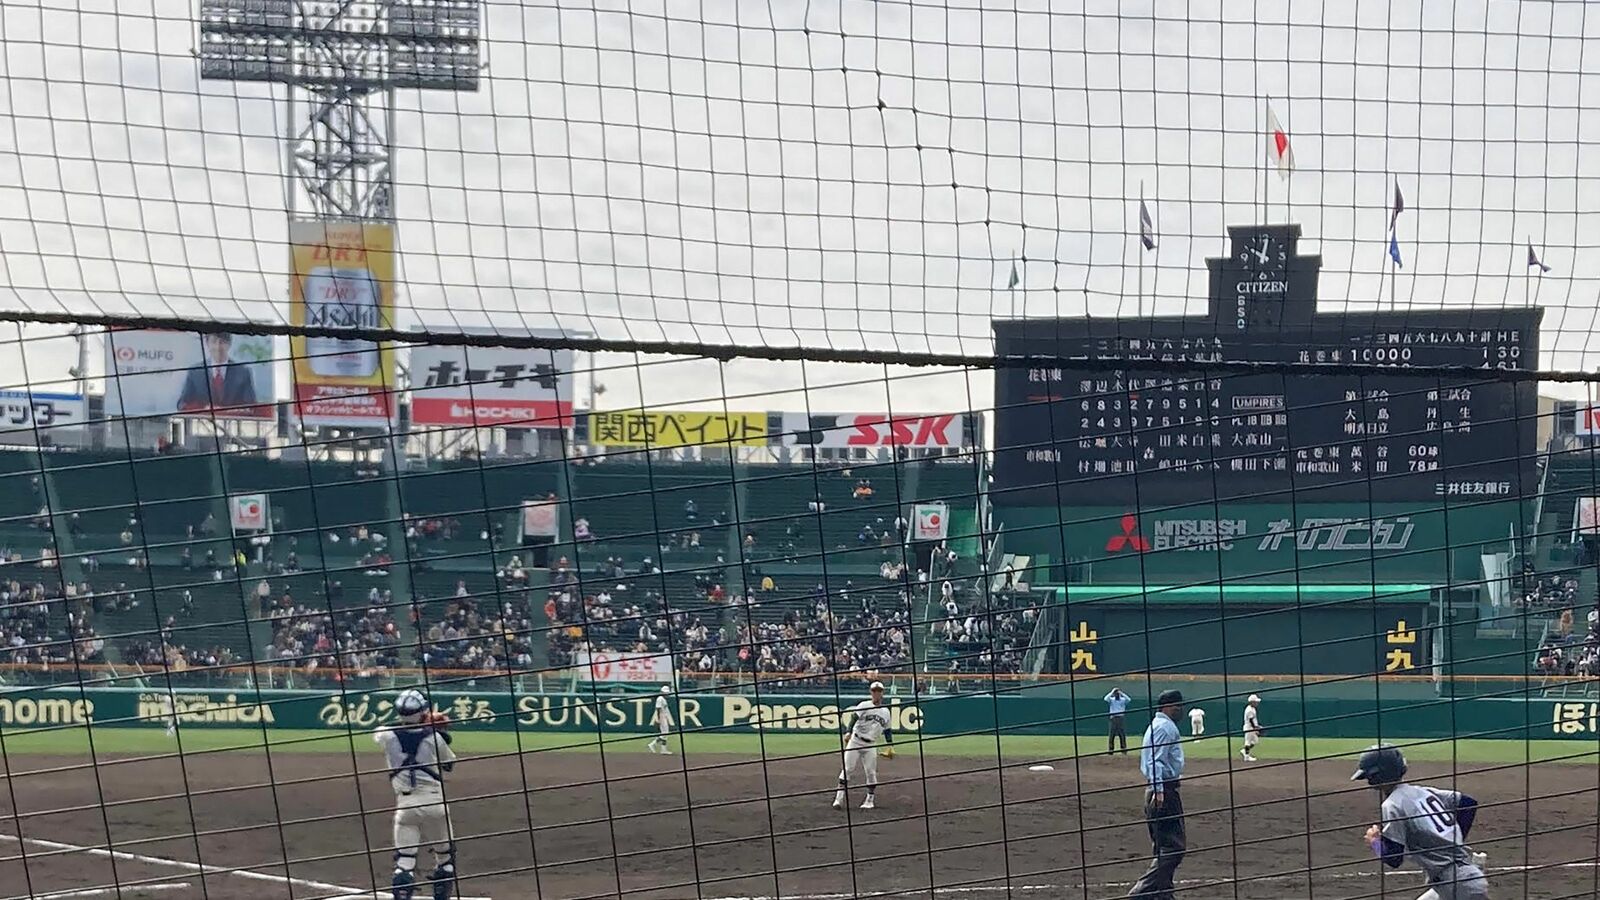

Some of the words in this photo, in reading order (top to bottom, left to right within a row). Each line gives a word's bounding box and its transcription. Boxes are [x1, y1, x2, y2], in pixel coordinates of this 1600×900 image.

[1236, 281, 1288, 293] CITIZEN
[137, 350, 173, 361] MUFG
[425, 360, 560, 389] ホーチキ
[1236, 396, 1284, 407] UMPIRES
[0, 402, 72, 425] ッター
[464, 407, 535, 419] HOCHIKI
[594, 413, 764, 444] 関西ペイント
[847, 414, 957, 446] SSK
[1435, 482, 1511, 495] 三井住友銀行
[1154, 519, 1247, 535] MITSUBISHI
[1154, 536, 1234, 551] ELECTRIC
[518, 695, 702, 727] SUNSTAR
[1420, 795, 1456, 834] 10
